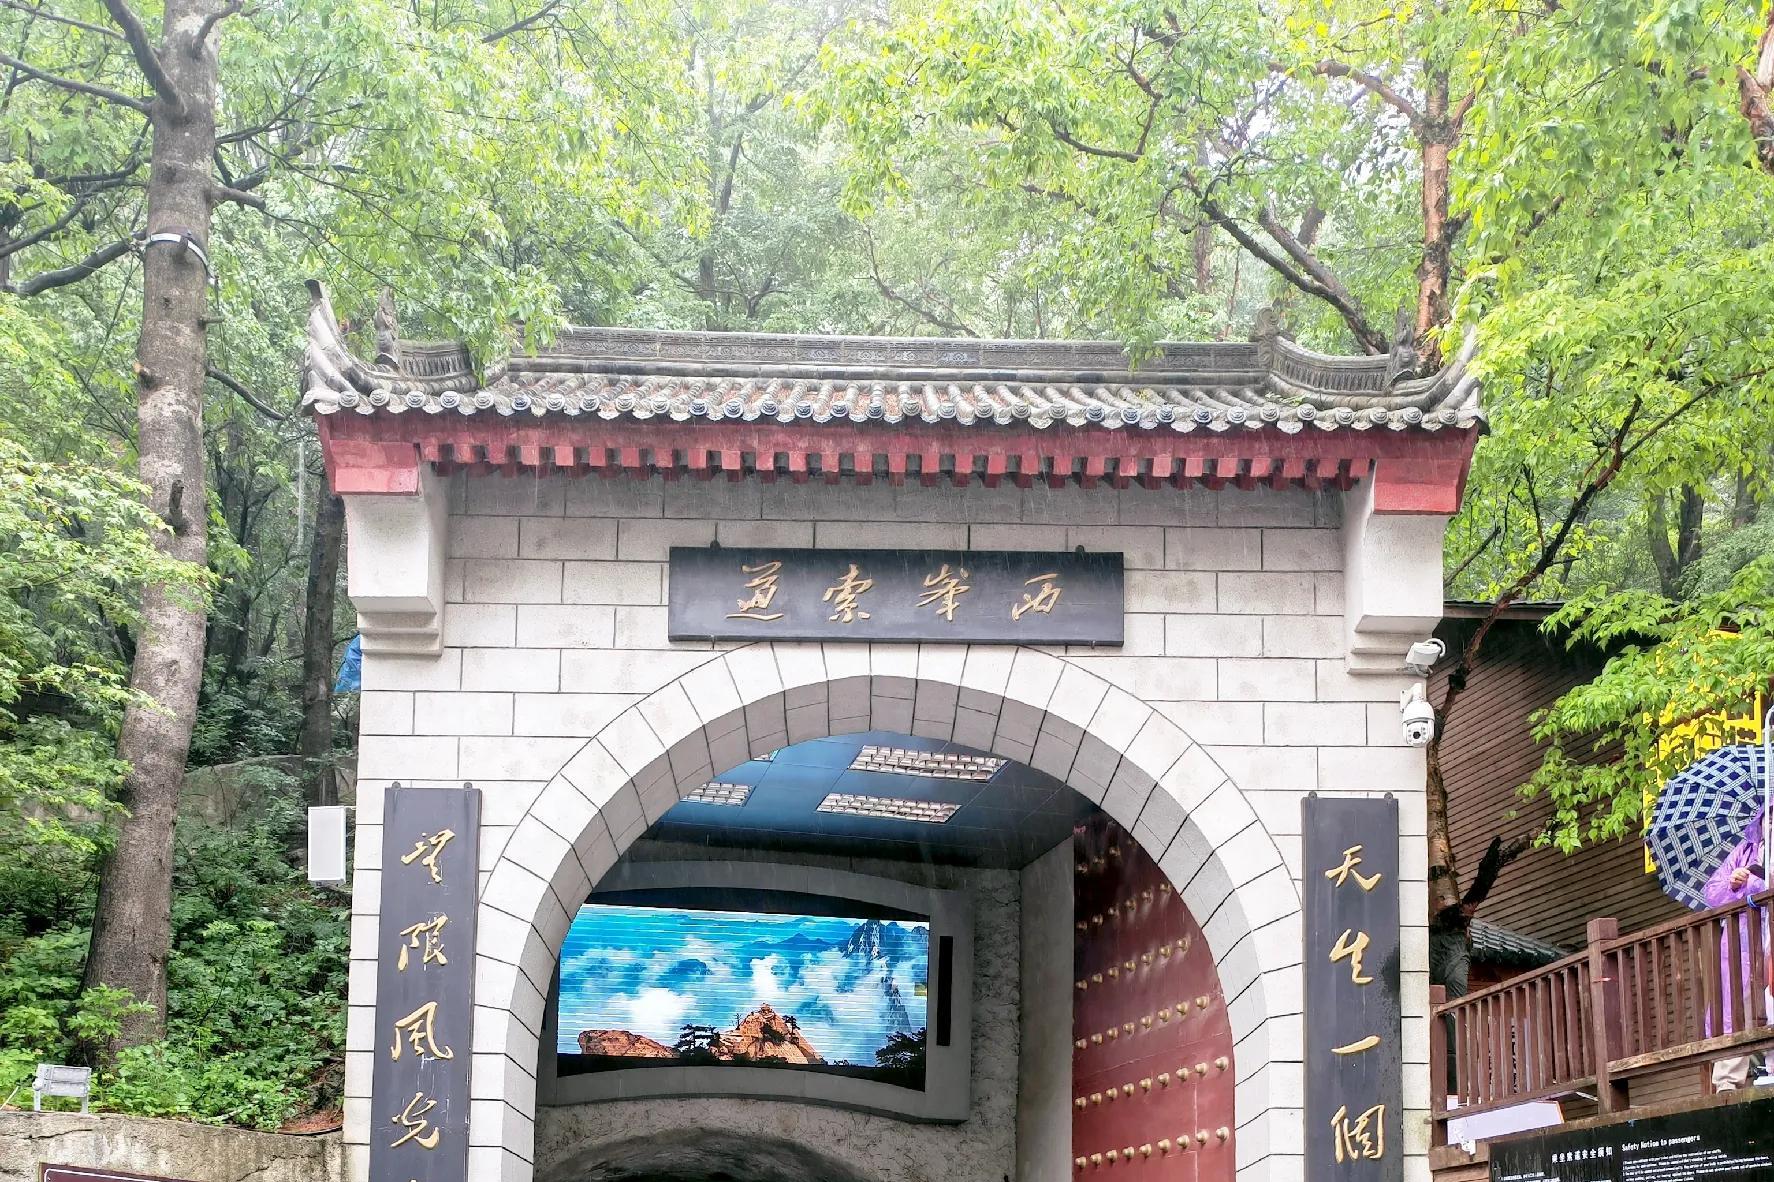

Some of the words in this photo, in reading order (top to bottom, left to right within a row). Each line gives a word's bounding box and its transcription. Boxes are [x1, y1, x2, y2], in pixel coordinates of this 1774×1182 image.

[1621, 1142, 1640, 1152] Safety
[1660, 1138, 1667, 1146] to
[1668, 1134, 1701, 1147] passengers
